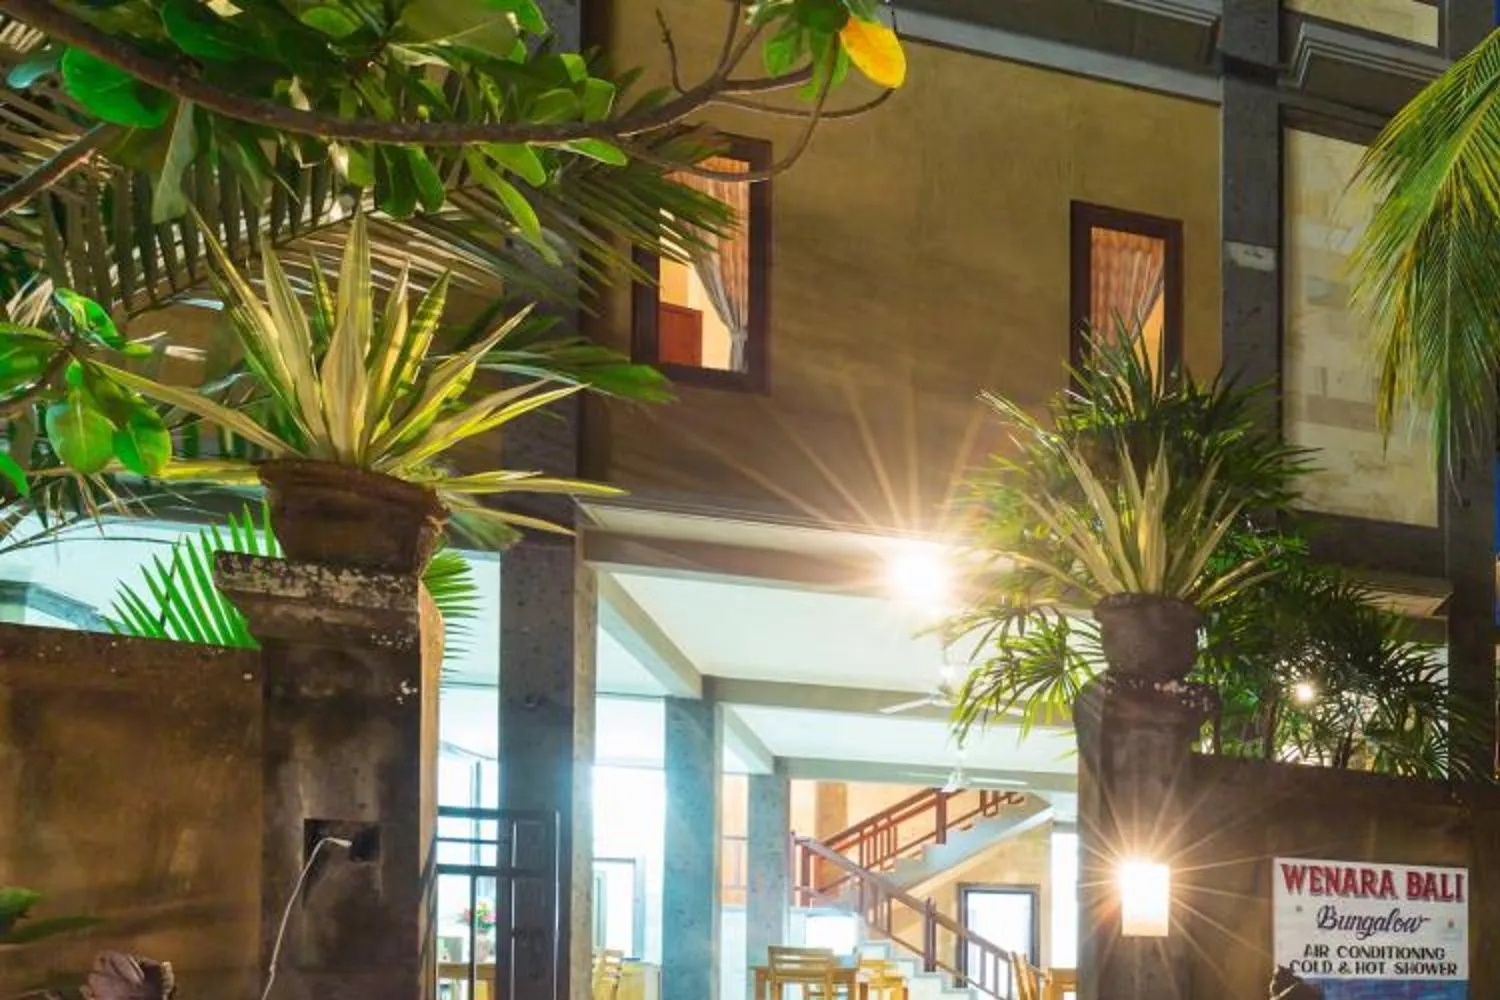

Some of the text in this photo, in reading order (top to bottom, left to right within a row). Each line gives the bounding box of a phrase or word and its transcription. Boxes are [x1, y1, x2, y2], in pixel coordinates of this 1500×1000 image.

[1280, 863, 1465, 902] WENARA BALI
[1316, 904, 1431, 940] Bungalow
[1303, 943, 1446, 961] AIR CONDITIONING
[1289, 959, 1459, 976] COLD & HOT SHOWER
